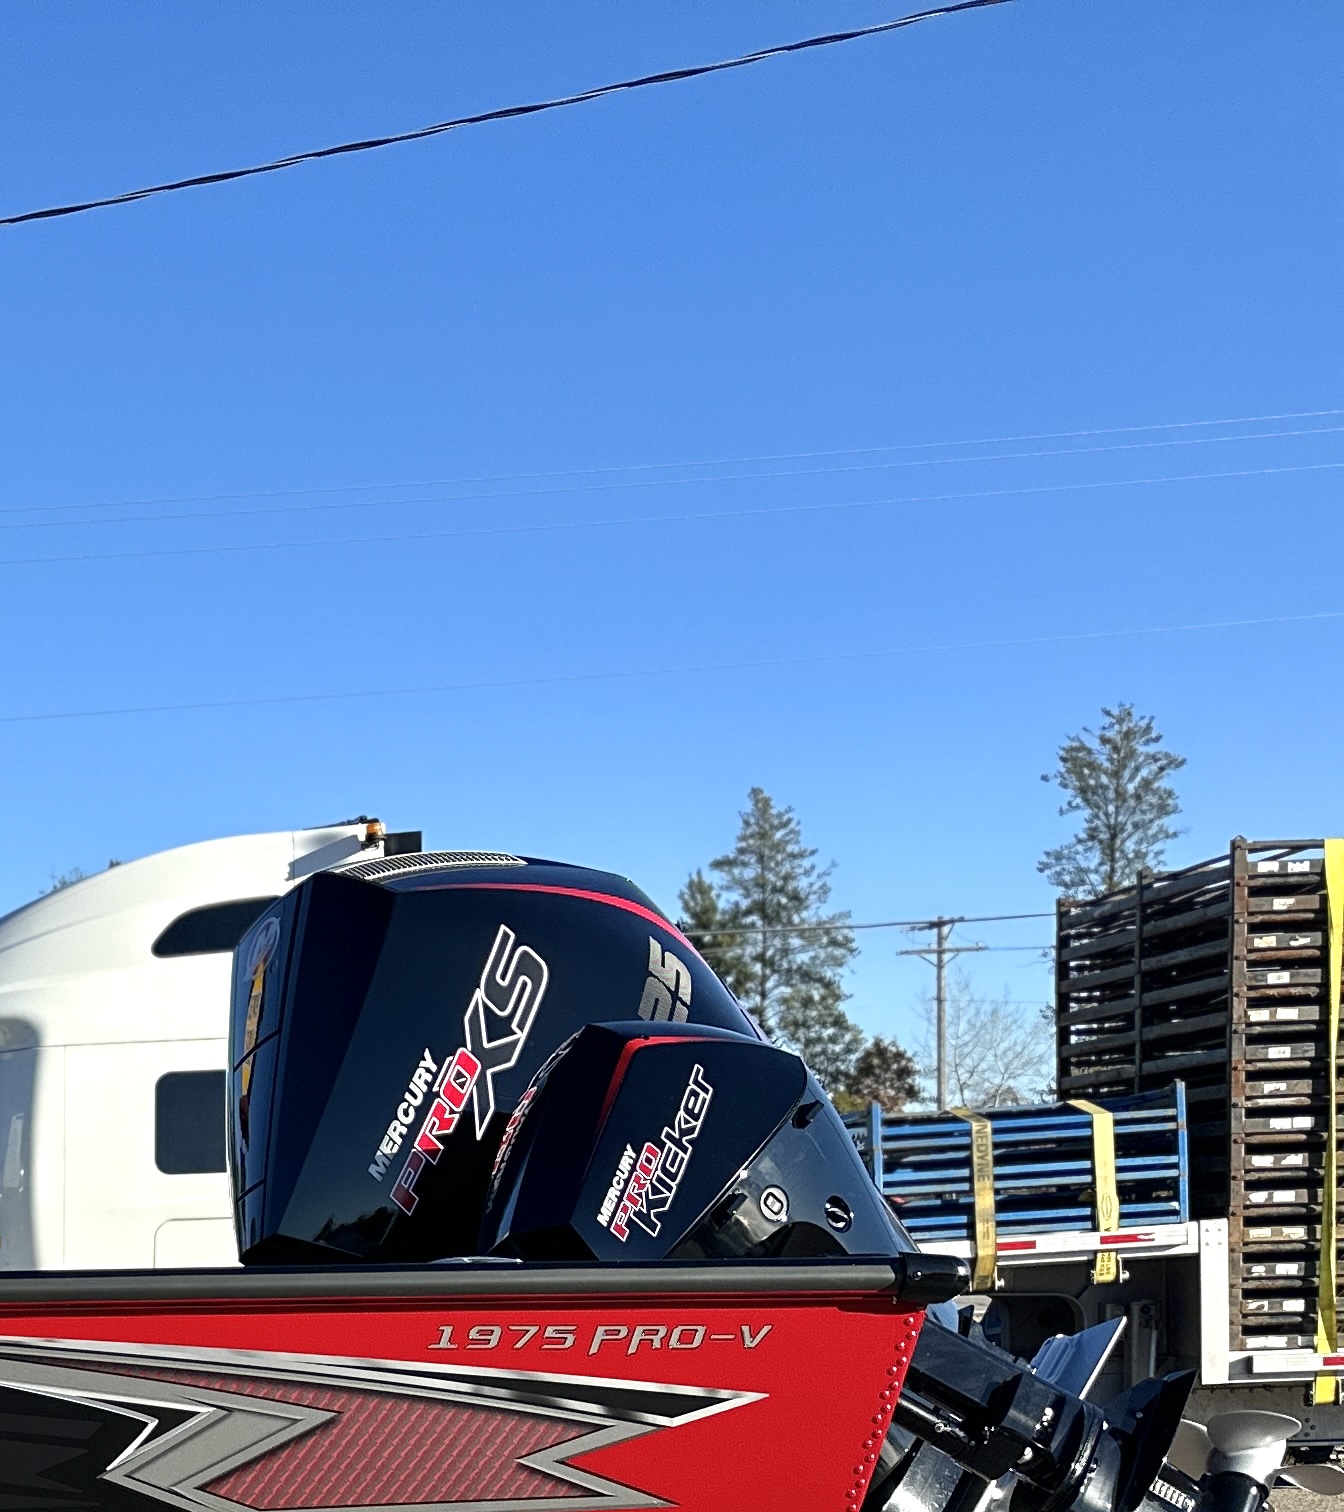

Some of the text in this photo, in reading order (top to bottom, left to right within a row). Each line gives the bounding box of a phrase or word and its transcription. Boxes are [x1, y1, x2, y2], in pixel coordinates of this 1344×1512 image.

[368, 1047, 439, 1183] MERCURY
[389, 1047, 482, 1217] PRO
[464, 923, 550, 1142] XS
[596, 1142, 638, 1228] MERCURY
[610, 1141, 662, 1244] PRO
[426, 1325, 774, 1357] 1975 PRO-V
